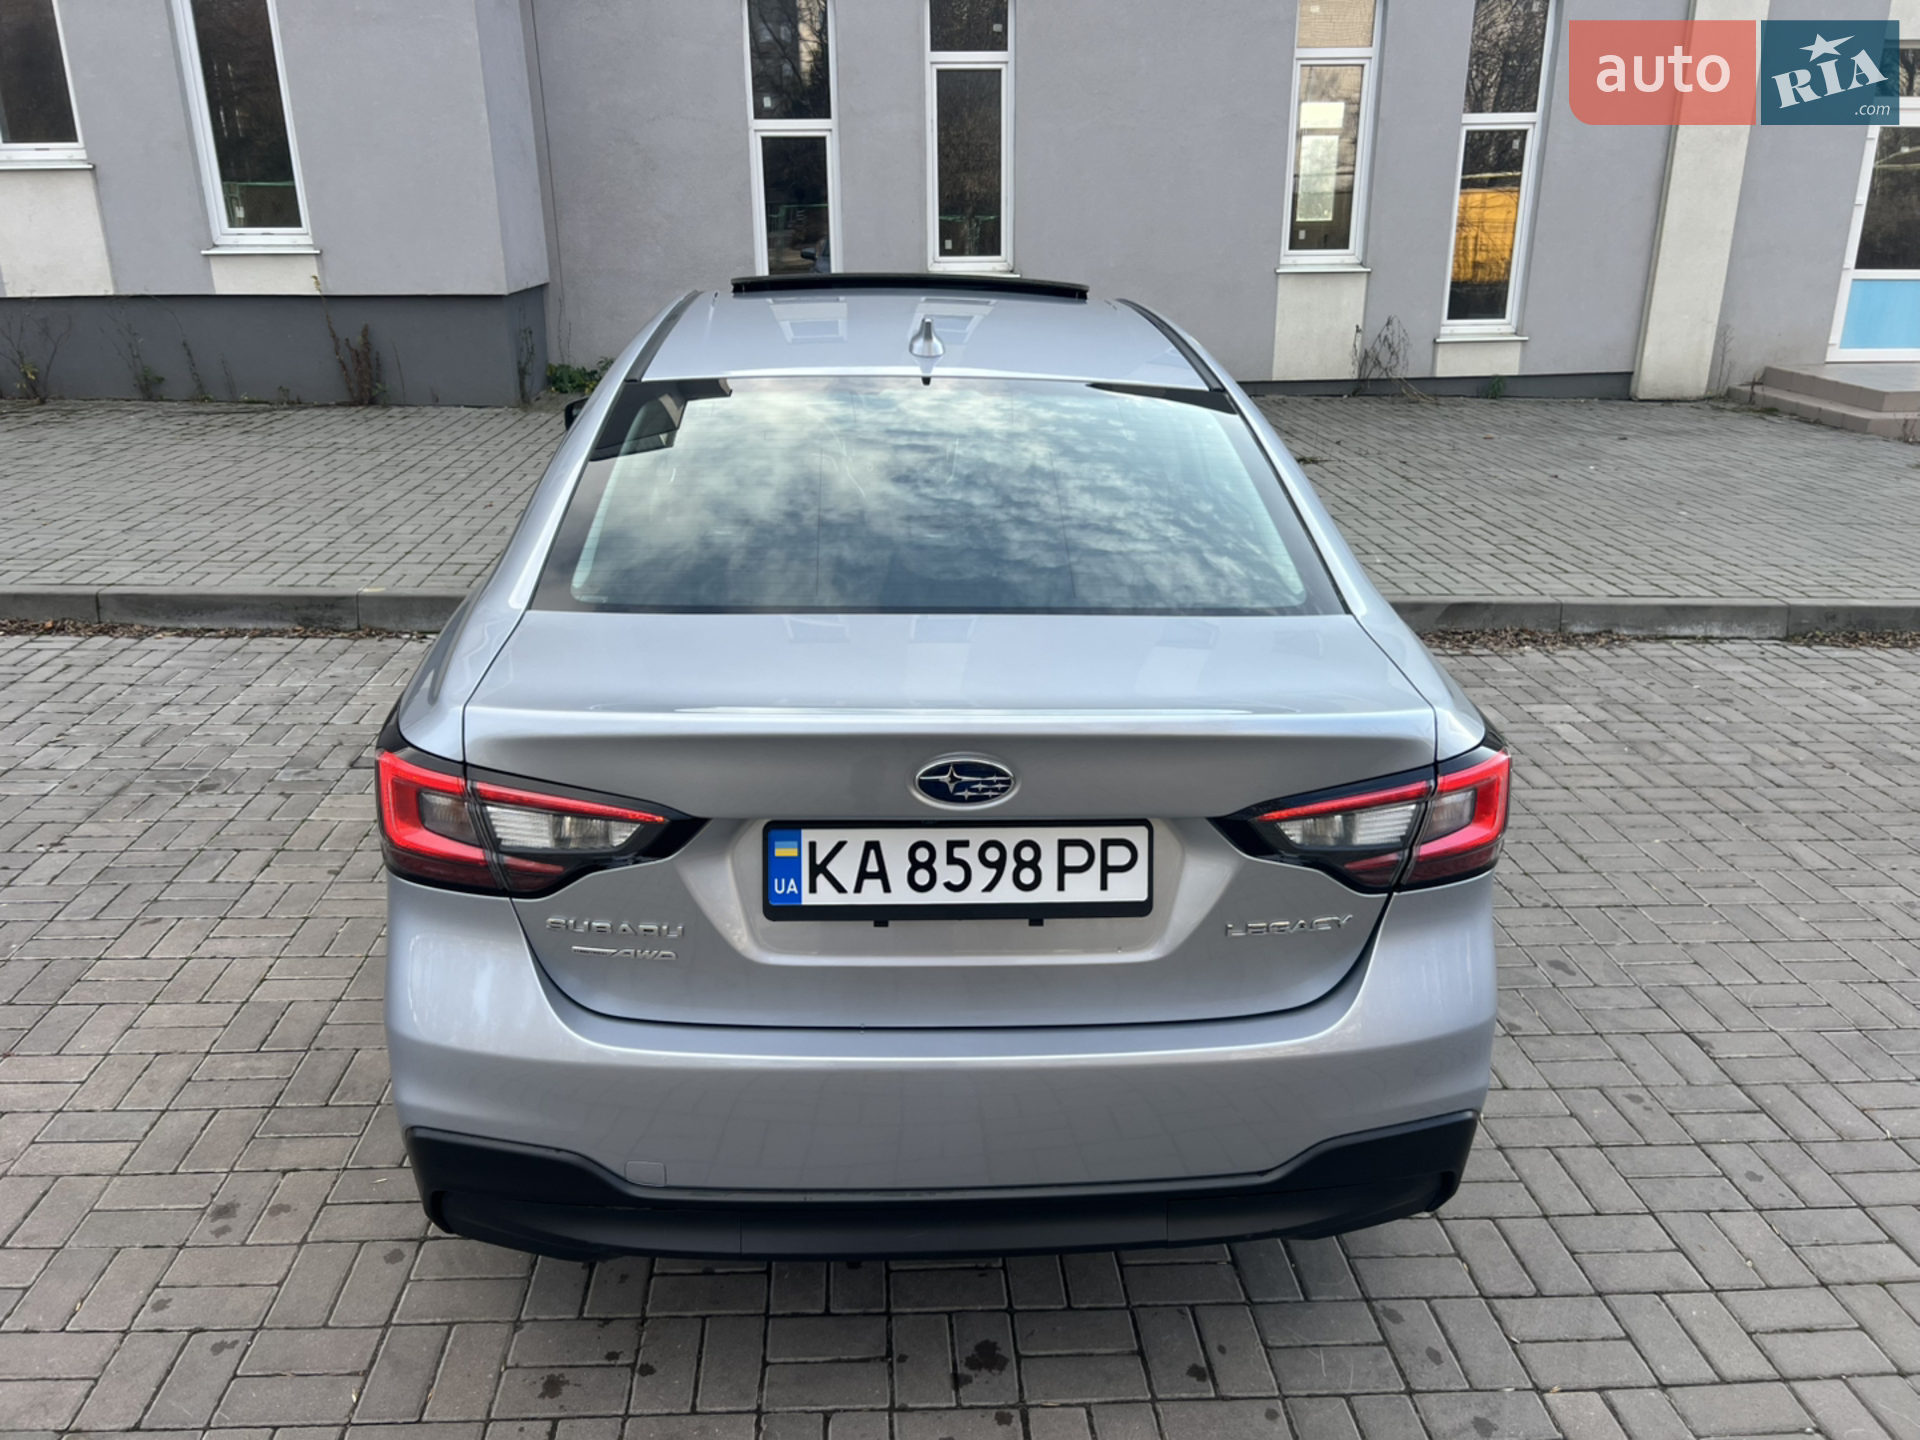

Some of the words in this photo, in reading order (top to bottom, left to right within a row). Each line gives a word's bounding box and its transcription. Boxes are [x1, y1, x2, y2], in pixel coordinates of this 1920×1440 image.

[808, 840, 892, 894] KA
[907, 839, 1042, 893] 8598
[1057, 838, 1138, 892] PP
[774, 878, 799, 895] UA
[546, 917, 685, 938] SUBARU
[1225, 914, 1353, 937] LEGACY
[611, 948, 679, 961] AWD
